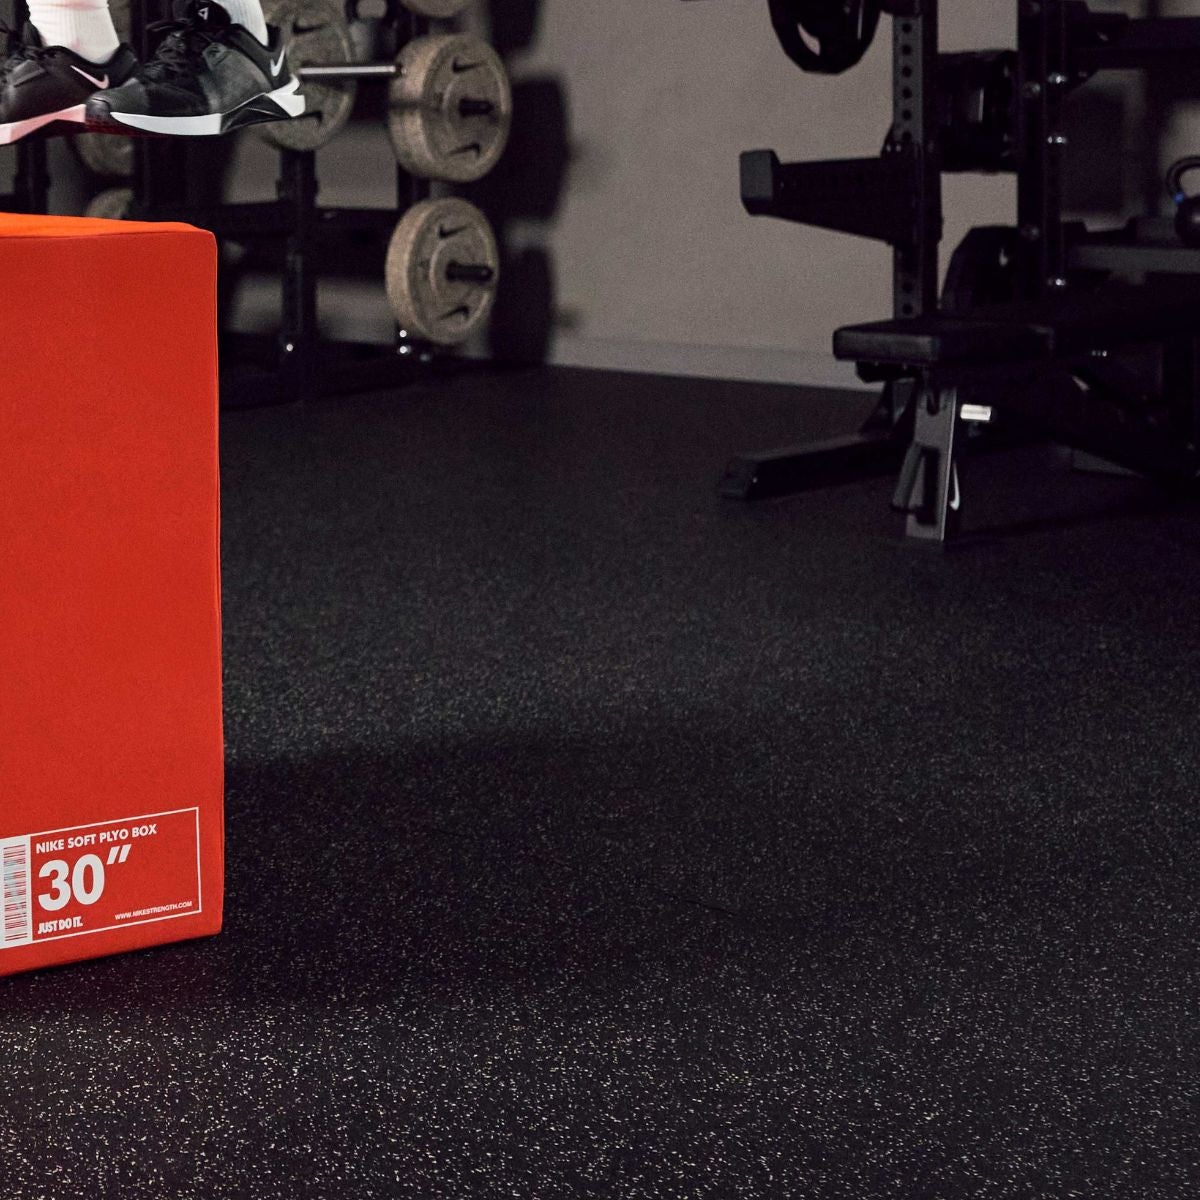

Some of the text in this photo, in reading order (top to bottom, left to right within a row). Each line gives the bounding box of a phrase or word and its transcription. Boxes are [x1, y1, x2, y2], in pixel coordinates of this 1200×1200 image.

[36, 823, 157, 854] NIKE SOFT PLYO BOX
[37, 915, 84, 935] JUST DO IT.
